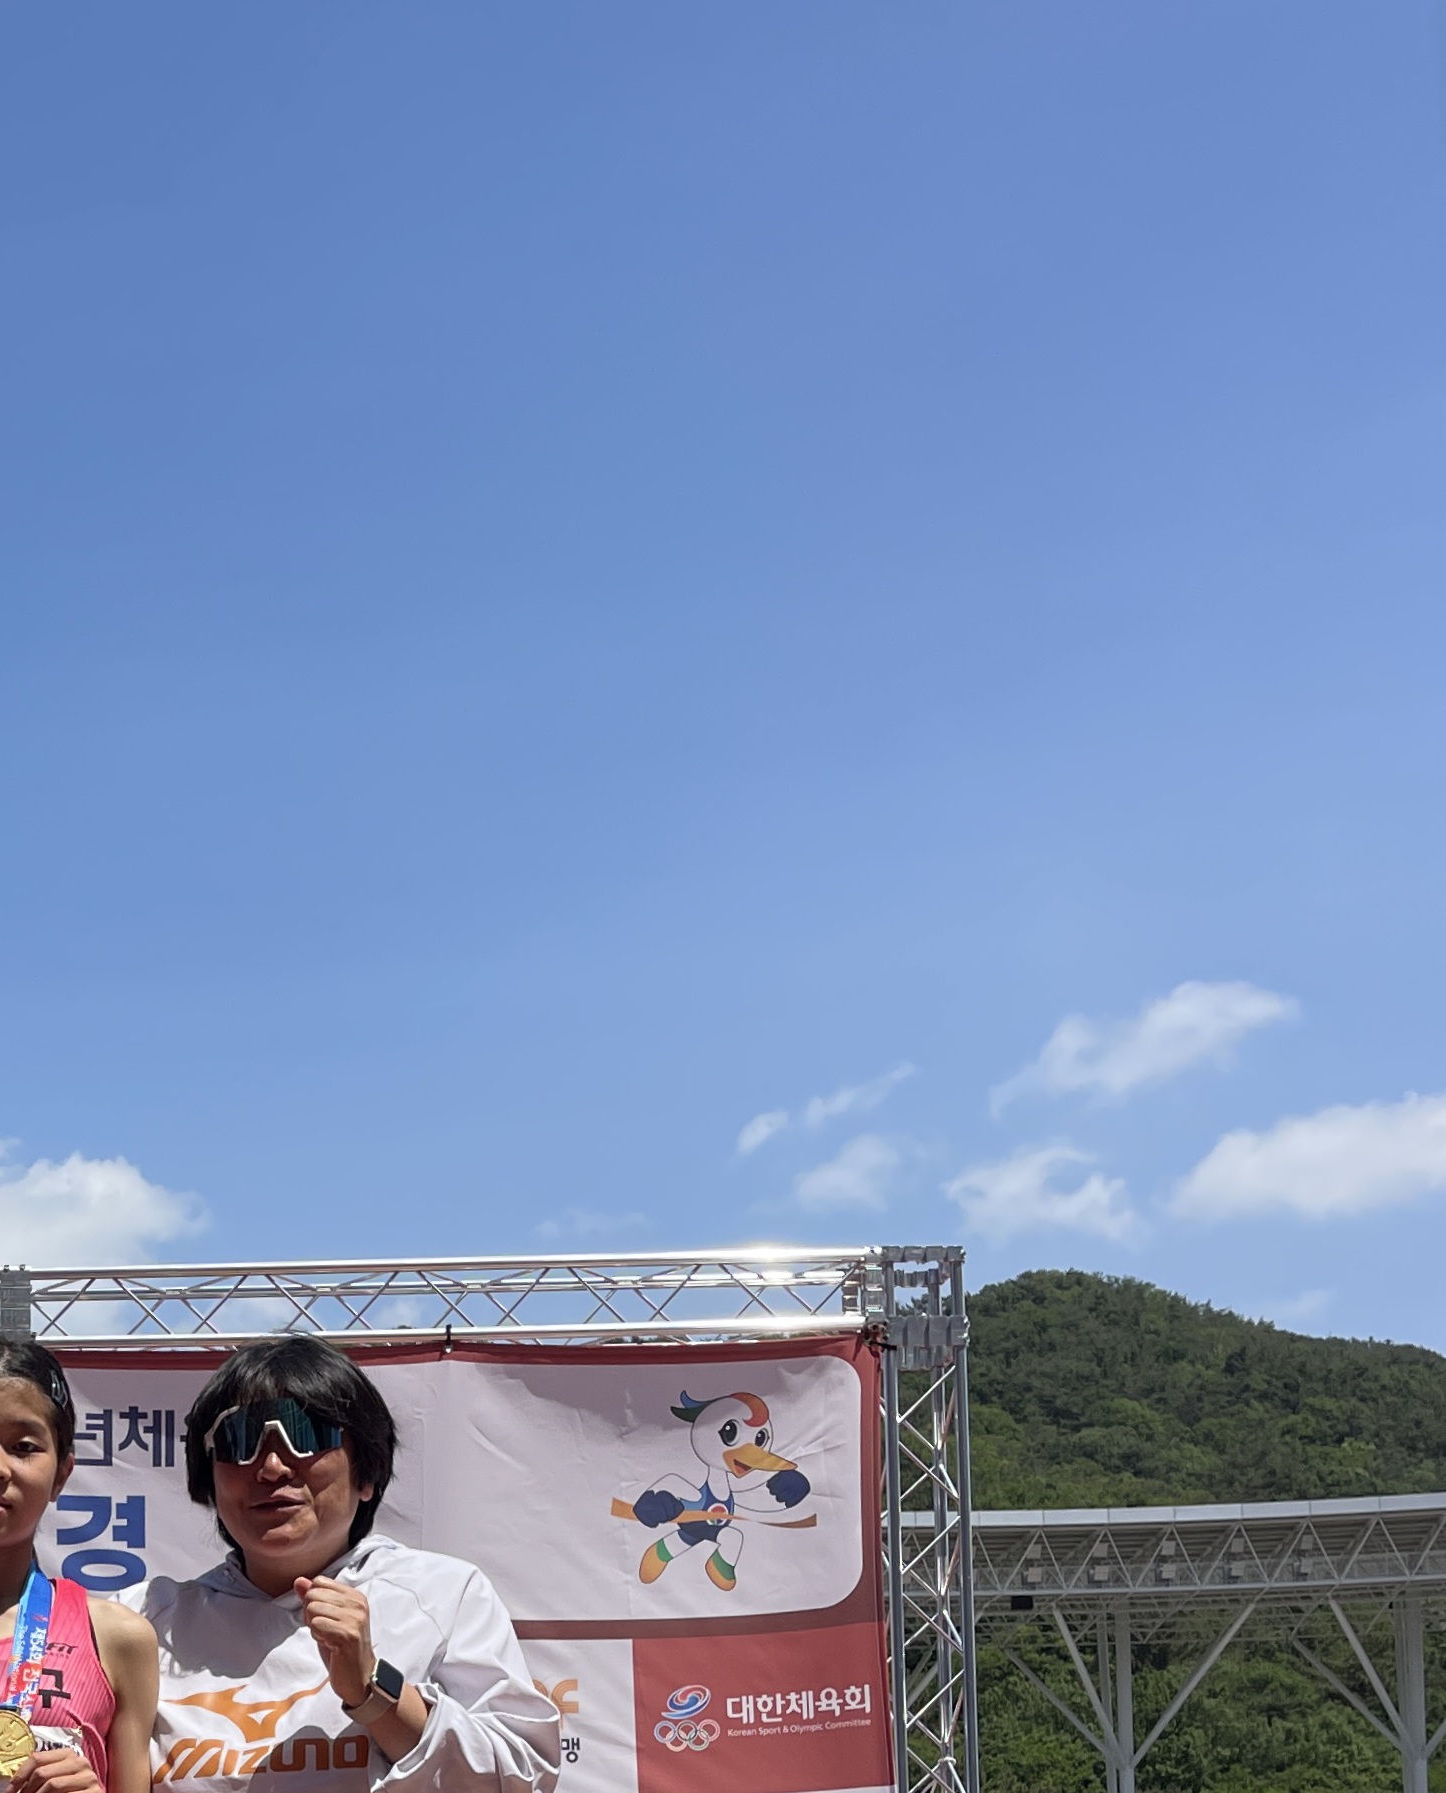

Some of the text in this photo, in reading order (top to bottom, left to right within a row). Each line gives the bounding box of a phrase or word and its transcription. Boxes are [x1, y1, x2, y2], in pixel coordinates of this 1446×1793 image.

[727, 1684, 871, 1724] 대한체육회
[759, 1727, 781, 1736] Sport
[790, 1724, 823, 1734] Olympic
[825, 1719, 871, 1729] Committee
[153, 1733, 370, 1785] MIZUNO
